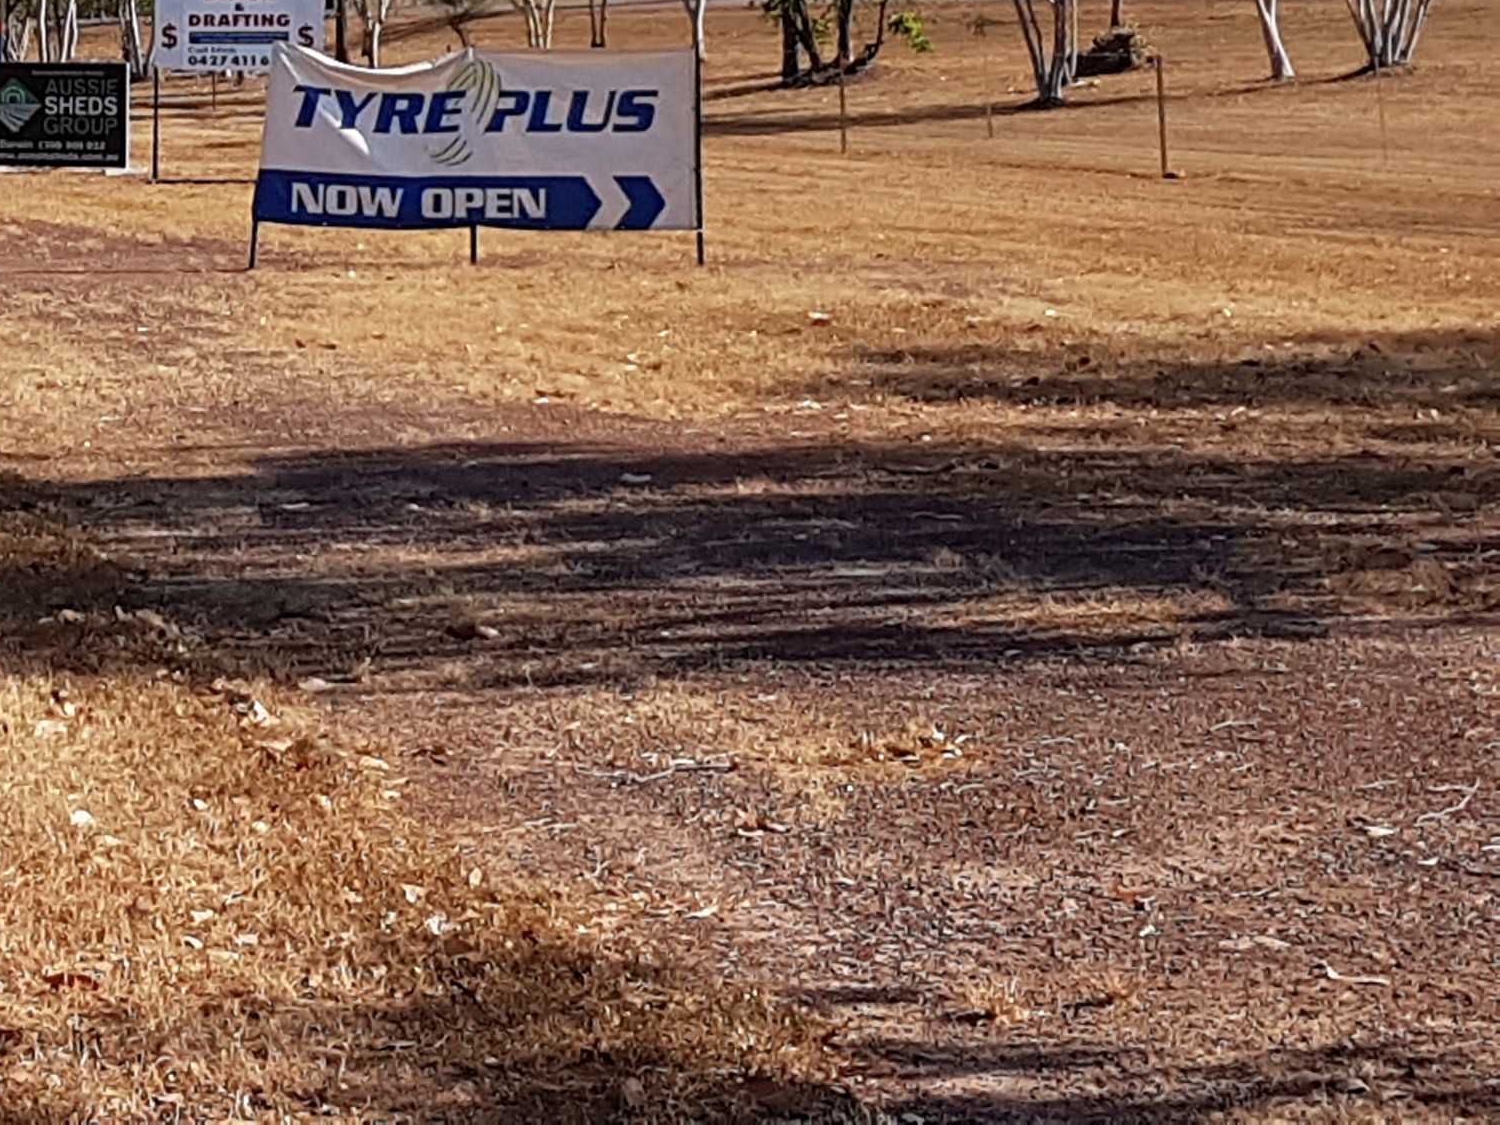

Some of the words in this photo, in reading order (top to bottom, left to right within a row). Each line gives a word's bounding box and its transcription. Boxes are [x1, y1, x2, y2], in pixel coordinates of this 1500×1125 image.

[235, 3, 244, 12] &
[188, 14, 290, 27] DRAFTING
[161, 23, 177, 49] $
[44, 79, 118, 95] AUSSIE
[44, 96, 118, 116] SHEDS
[293, 85, 466, 134] TYRE
[485, 90, 659, 133] PLUS
[43, 116, 118, 135] GROUP
[291, 182, 404, 217] NOW
[421, 187, 547, 220] OPEN
